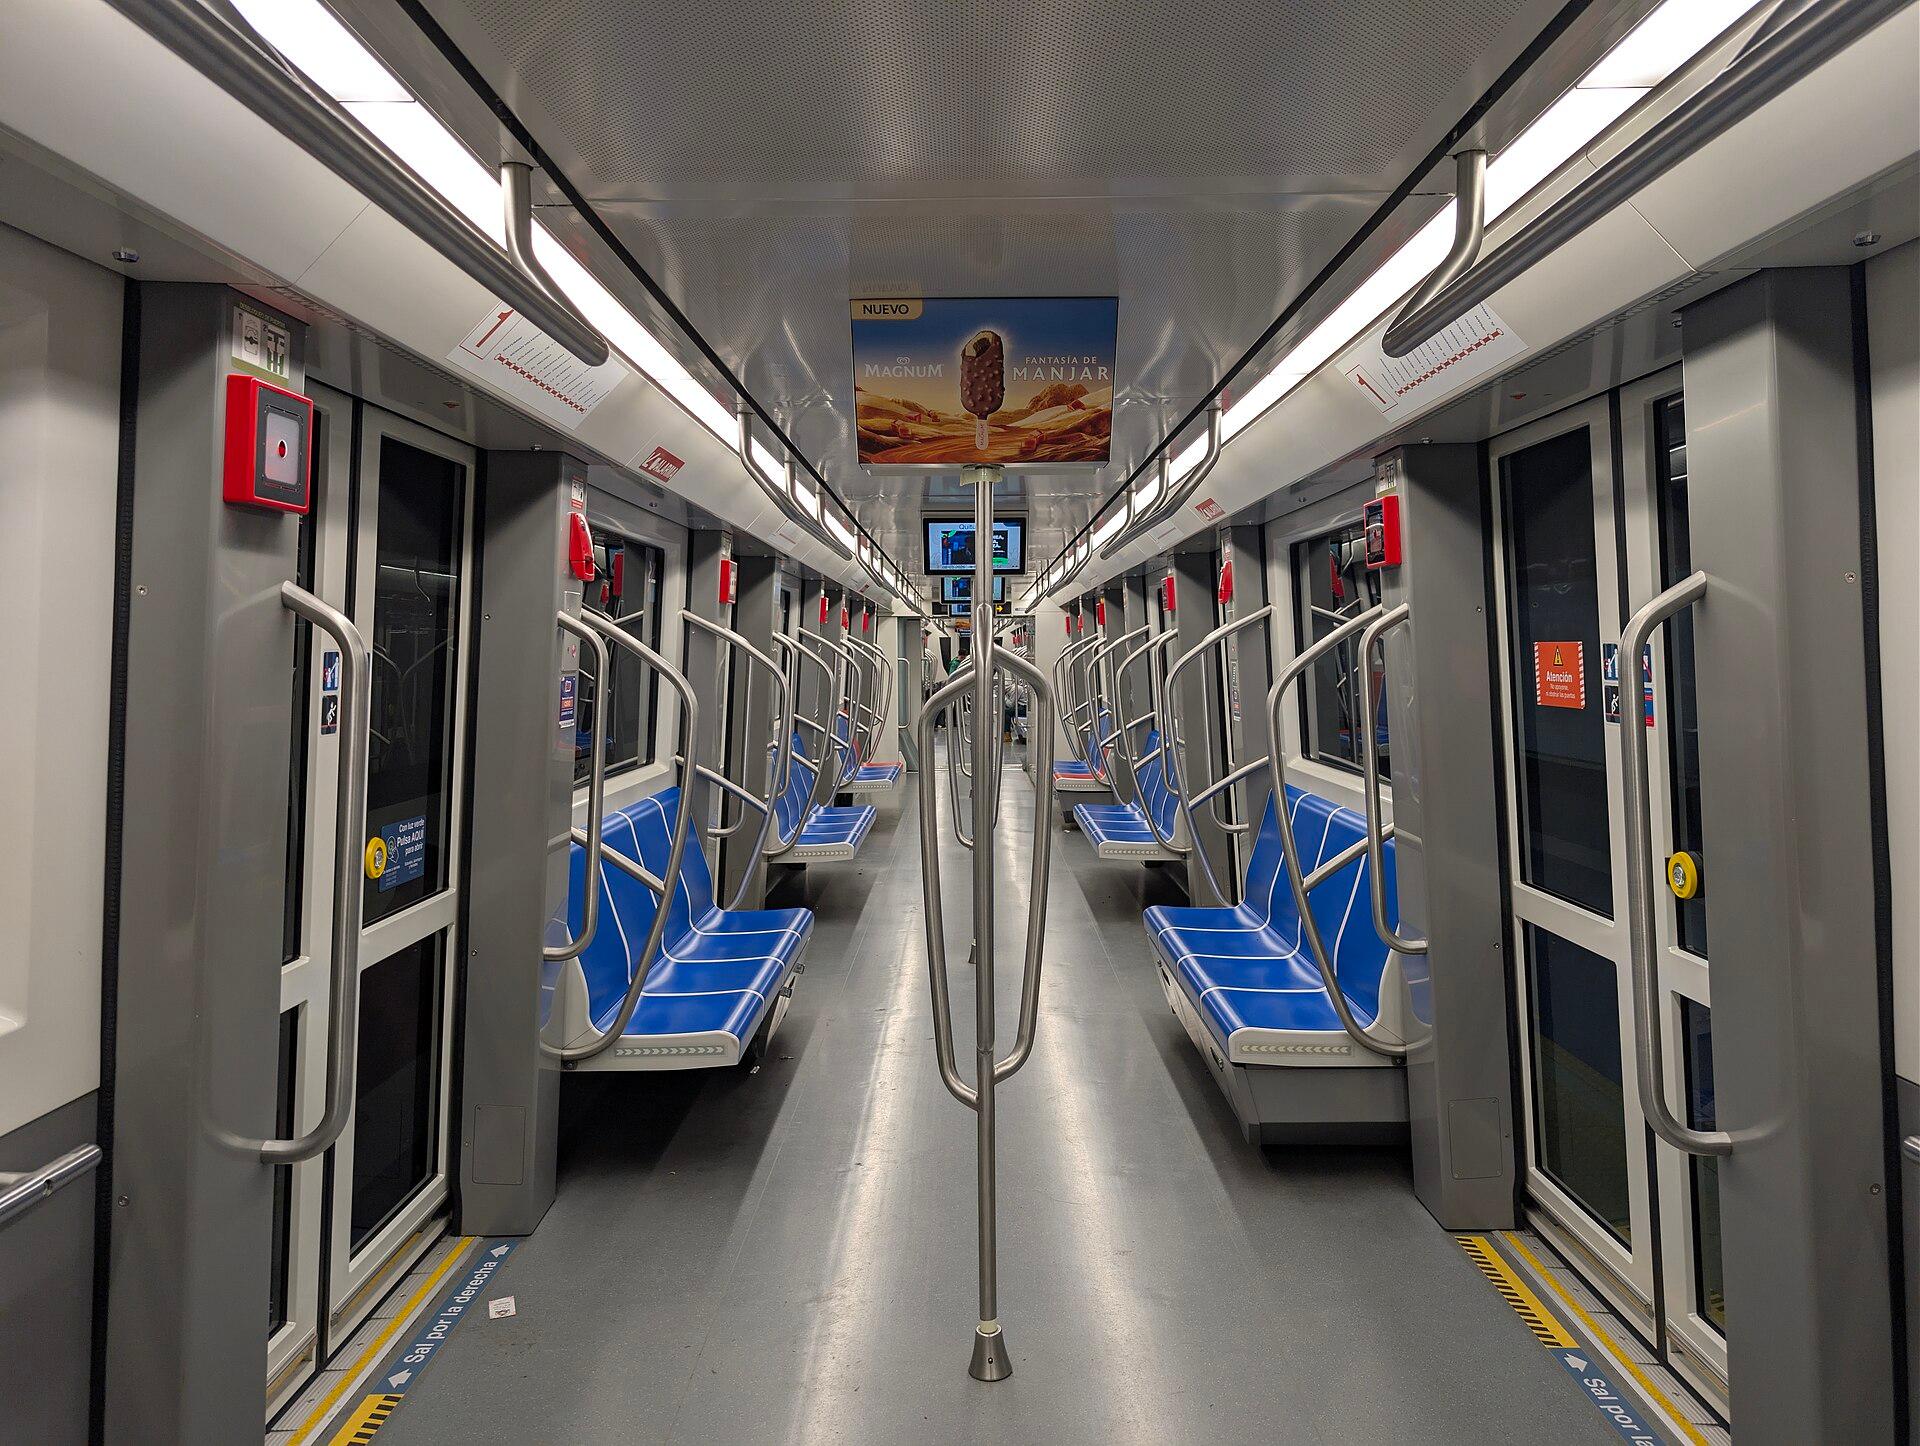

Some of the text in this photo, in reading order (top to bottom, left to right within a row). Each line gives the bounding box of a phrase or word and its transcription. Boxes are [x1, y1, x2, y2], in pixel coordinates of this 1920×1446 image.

[863, 303, 909, 315] NUEVO
[475, 308, 515, 348] 1
[1025, 354, 1097, 365] FANTASÍA DE
[864, 363, 943, 379] MAGNUM
[1012, 367, 1110, 382] MANJAR
[1356, 373, 1387, 405] 1
[1546, 670, 1572, 683] Atención
[397, 828, 424, 847] Pulsa AQUÍ
[404, 1261, 499, 1363] Sal por la derecha
[1583, 1378, 1654, 1446] Sal por la
